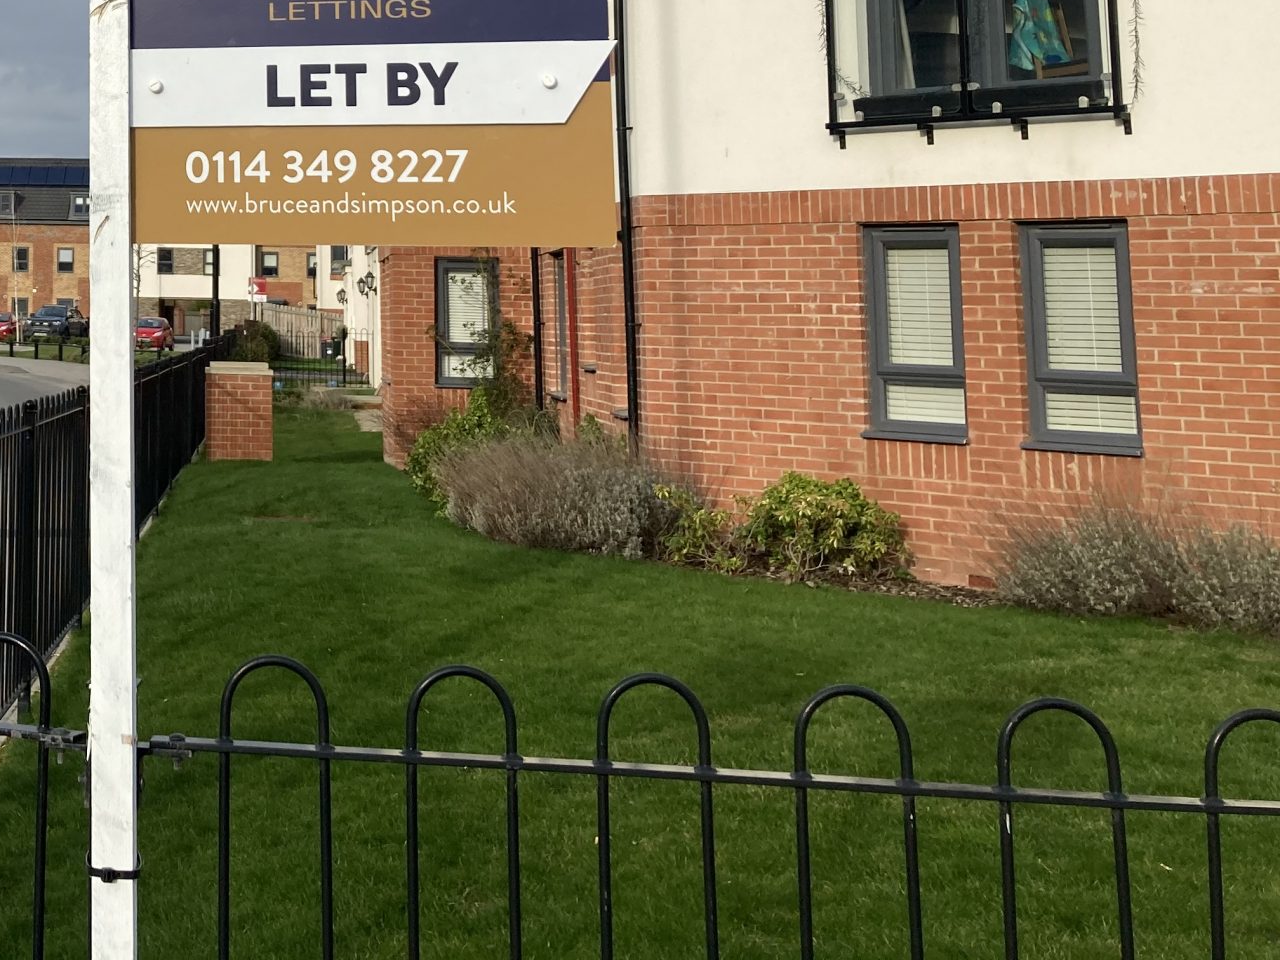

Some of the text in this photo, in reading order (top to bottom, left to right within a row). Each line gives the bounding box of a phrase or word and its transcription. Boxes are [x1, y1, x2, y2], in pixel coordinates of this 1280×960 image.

[265, 62, 460, 108] LET BY
[184, 149, 469, 184] 0114 349 8227
[186, 191, 517, 223] www.bruceandsimpson.co.uk
